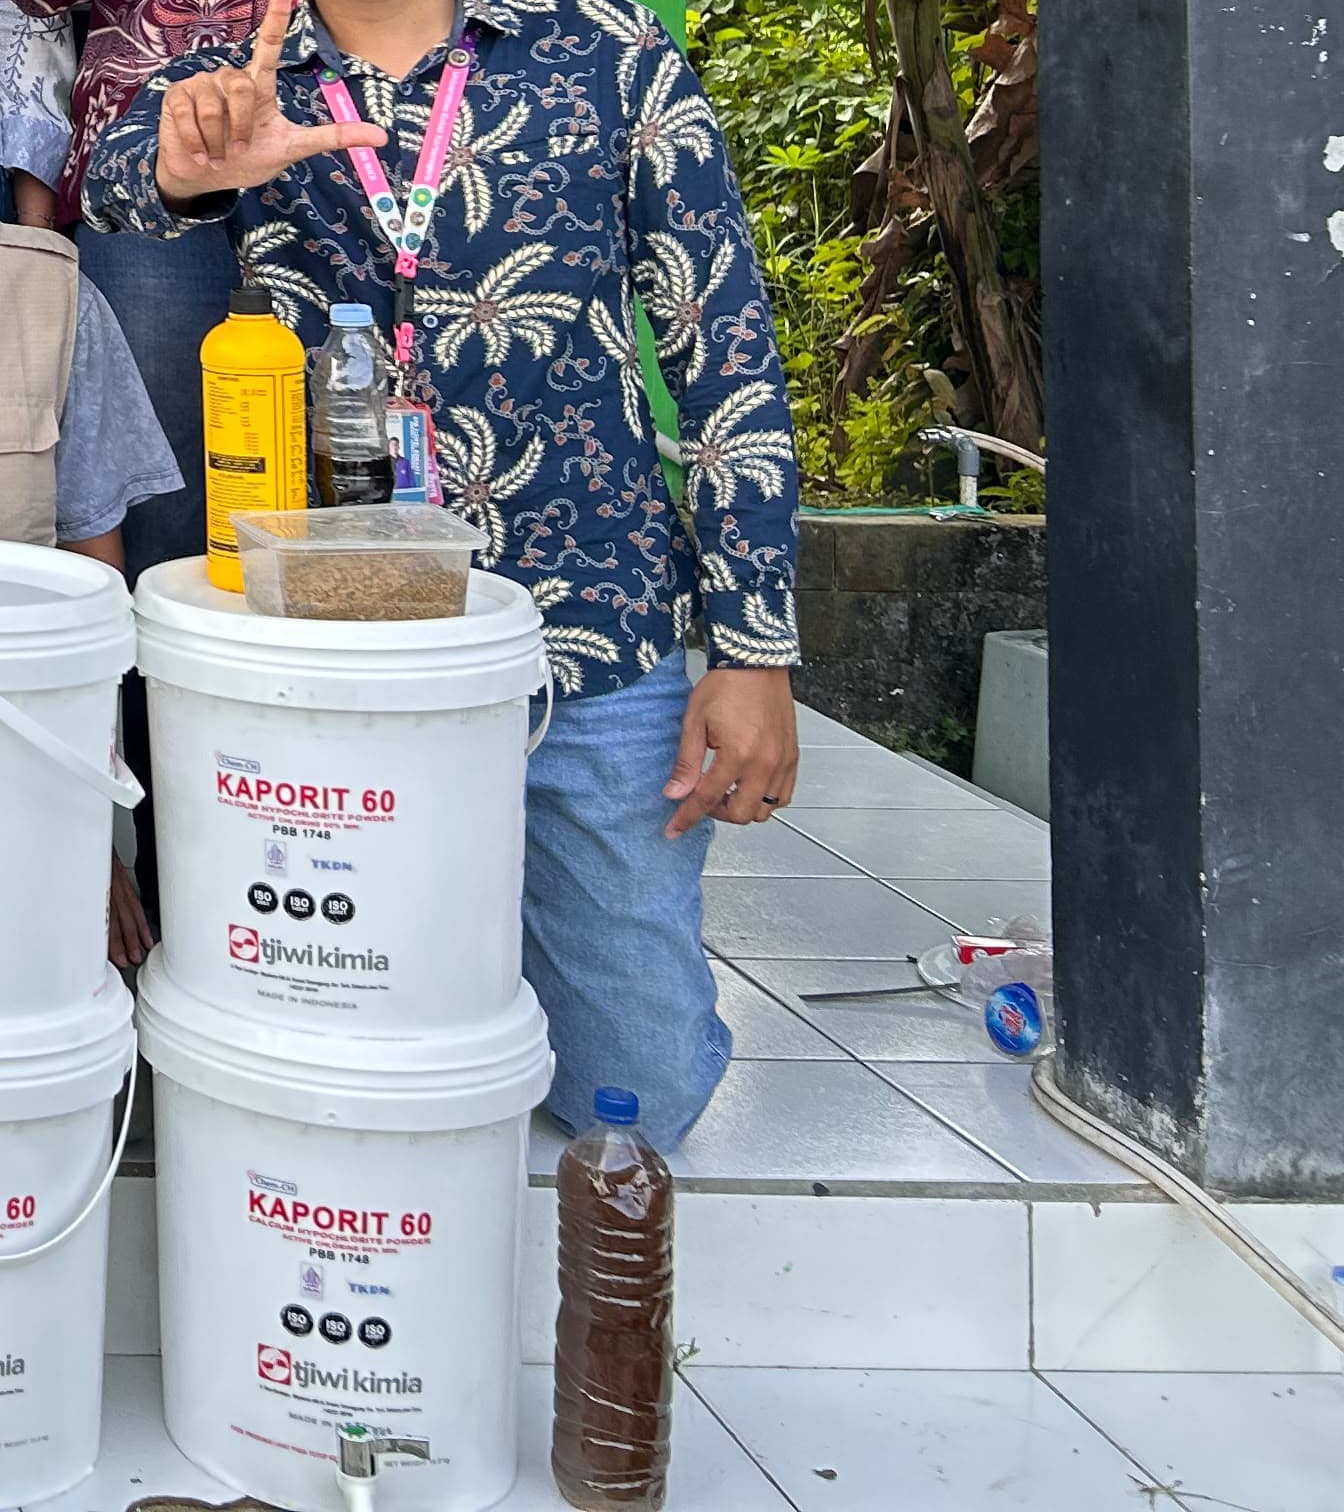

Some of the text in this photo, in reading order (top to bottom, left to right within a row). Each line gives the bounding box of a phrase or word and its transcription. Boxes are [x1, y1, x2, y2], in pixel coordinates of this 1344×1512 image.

[217, 771, 395, 813] KAPORIT 60
[347, 813, 395, 822] POWDER
[272, 824, 332, 840] PBB 1748
[254, 889, 272, 901] ISO
[290, 896, 310, 907] ISO
[328, 900, 348, 910] ISO
[259, 937, 389, 972] tjiwi kimia
[6, 1195, 36, 1221] 60
[248, 1189, 432, 1236] KAPORIT 60
[309, 1248, 370, 1264] PBB 1748
[288, 1312, 306, 1324] ISO
[326, 1320, 345, 1332] ISO
[365, 1325, 385, 1336] ISO
[293, 1359, 423, 1394] tjiwi kimia
